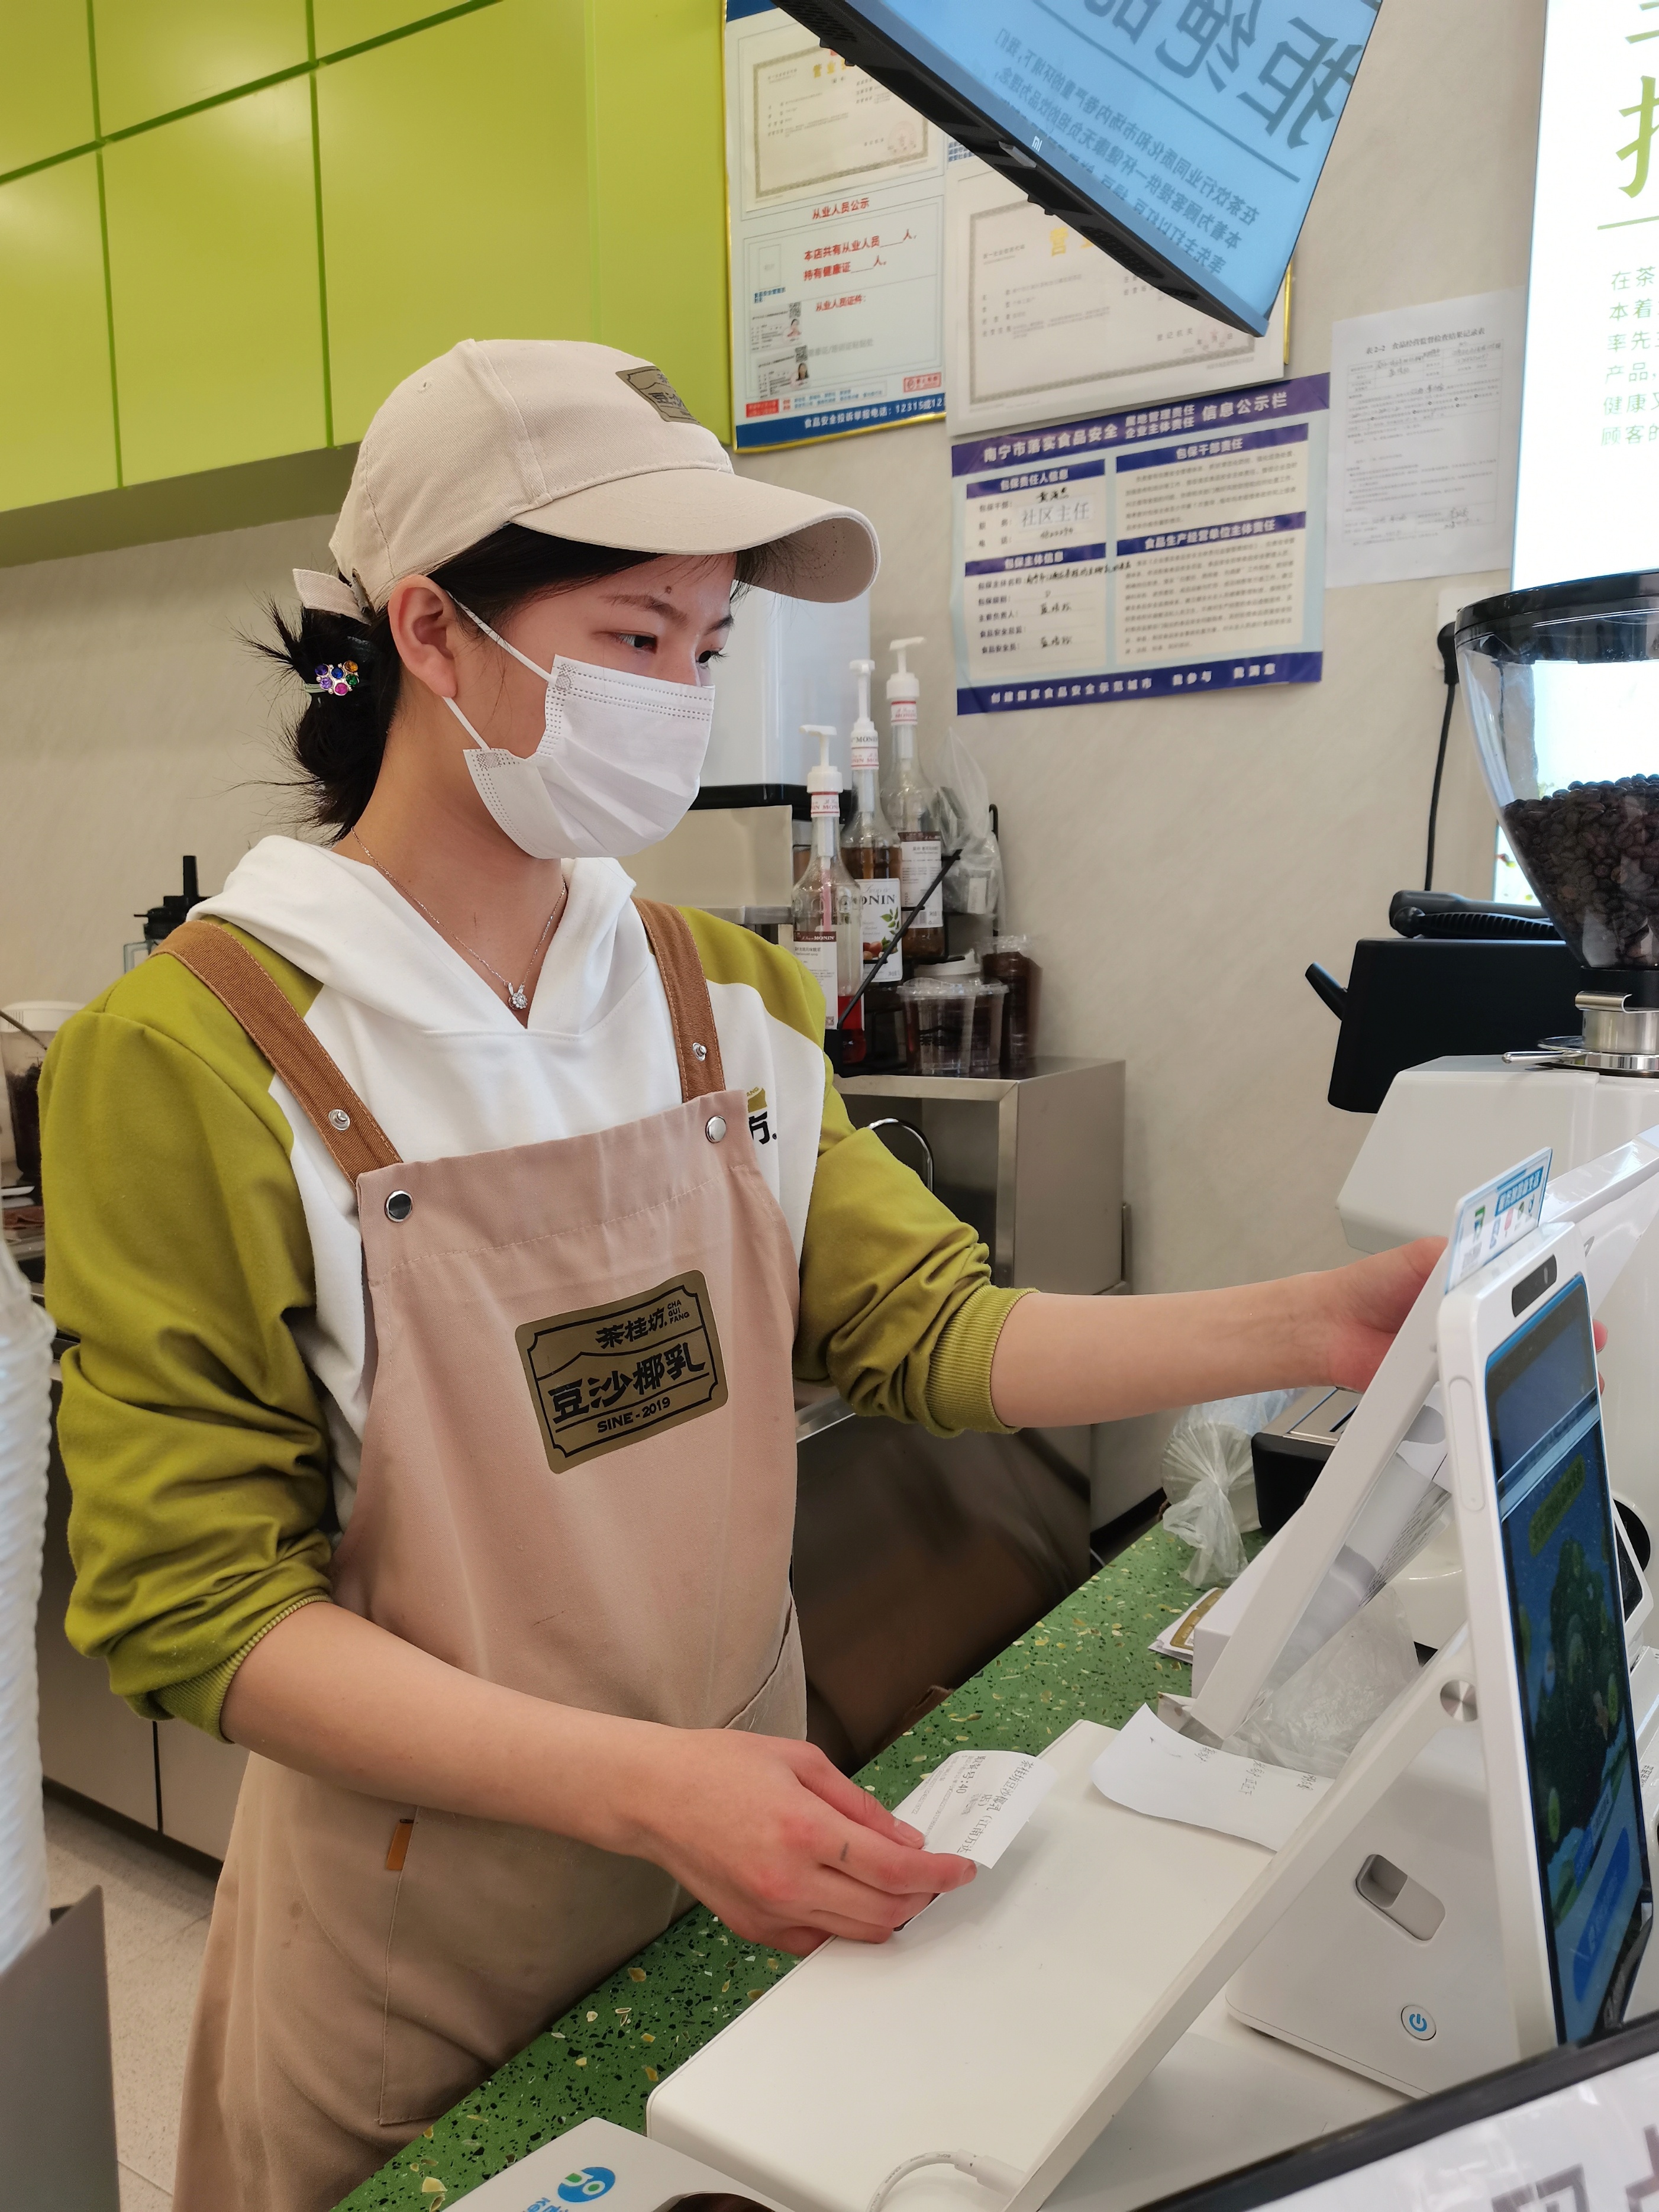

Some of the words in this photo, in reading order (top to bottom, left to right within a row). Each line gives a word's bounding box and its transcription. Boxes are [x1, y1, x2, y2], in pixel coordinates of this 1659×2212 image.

[812, 198, 870, 220] 从业人员公示
[805, 235, 880, 261] 本店共有从业人员
[803, 261, 851, 281] 持有健康证
[1610, 266, 1656, 291] 在茶
[1609, 298, 1659, 321] 本着
[1607, 330, 1659, 353] 率先
[984, 423, 1118, 463] 南宁市落实食品安全
[1125, 417, 1195, 440] 企业主体责任
[1202, 392, 1288, 422] 信息公示栏
[1176, 438, 1243, 460] 包保干部责任
[1000, 468, 1069, 491] 包保责任人信息
[1022, 501, 1092, 528] 社区主任
[1145, 518, 1276, 550] 食品生产经营单位主体责任
[1005, 550, 1064, 570] 包保主体信息
[991, 677, 1153, 704] 创建国家食品安全示范城市
[861, 894, 895, 905] ONIN
[746, 1086, 760, 1097] ANG
[667, 1299, 682, 1310] CHA
[668, 1307, 680, 1317] GUI
[669, 1311, 690, 1324] FANG
[547, 1342, 706, 1424] 豆沙椰乳
